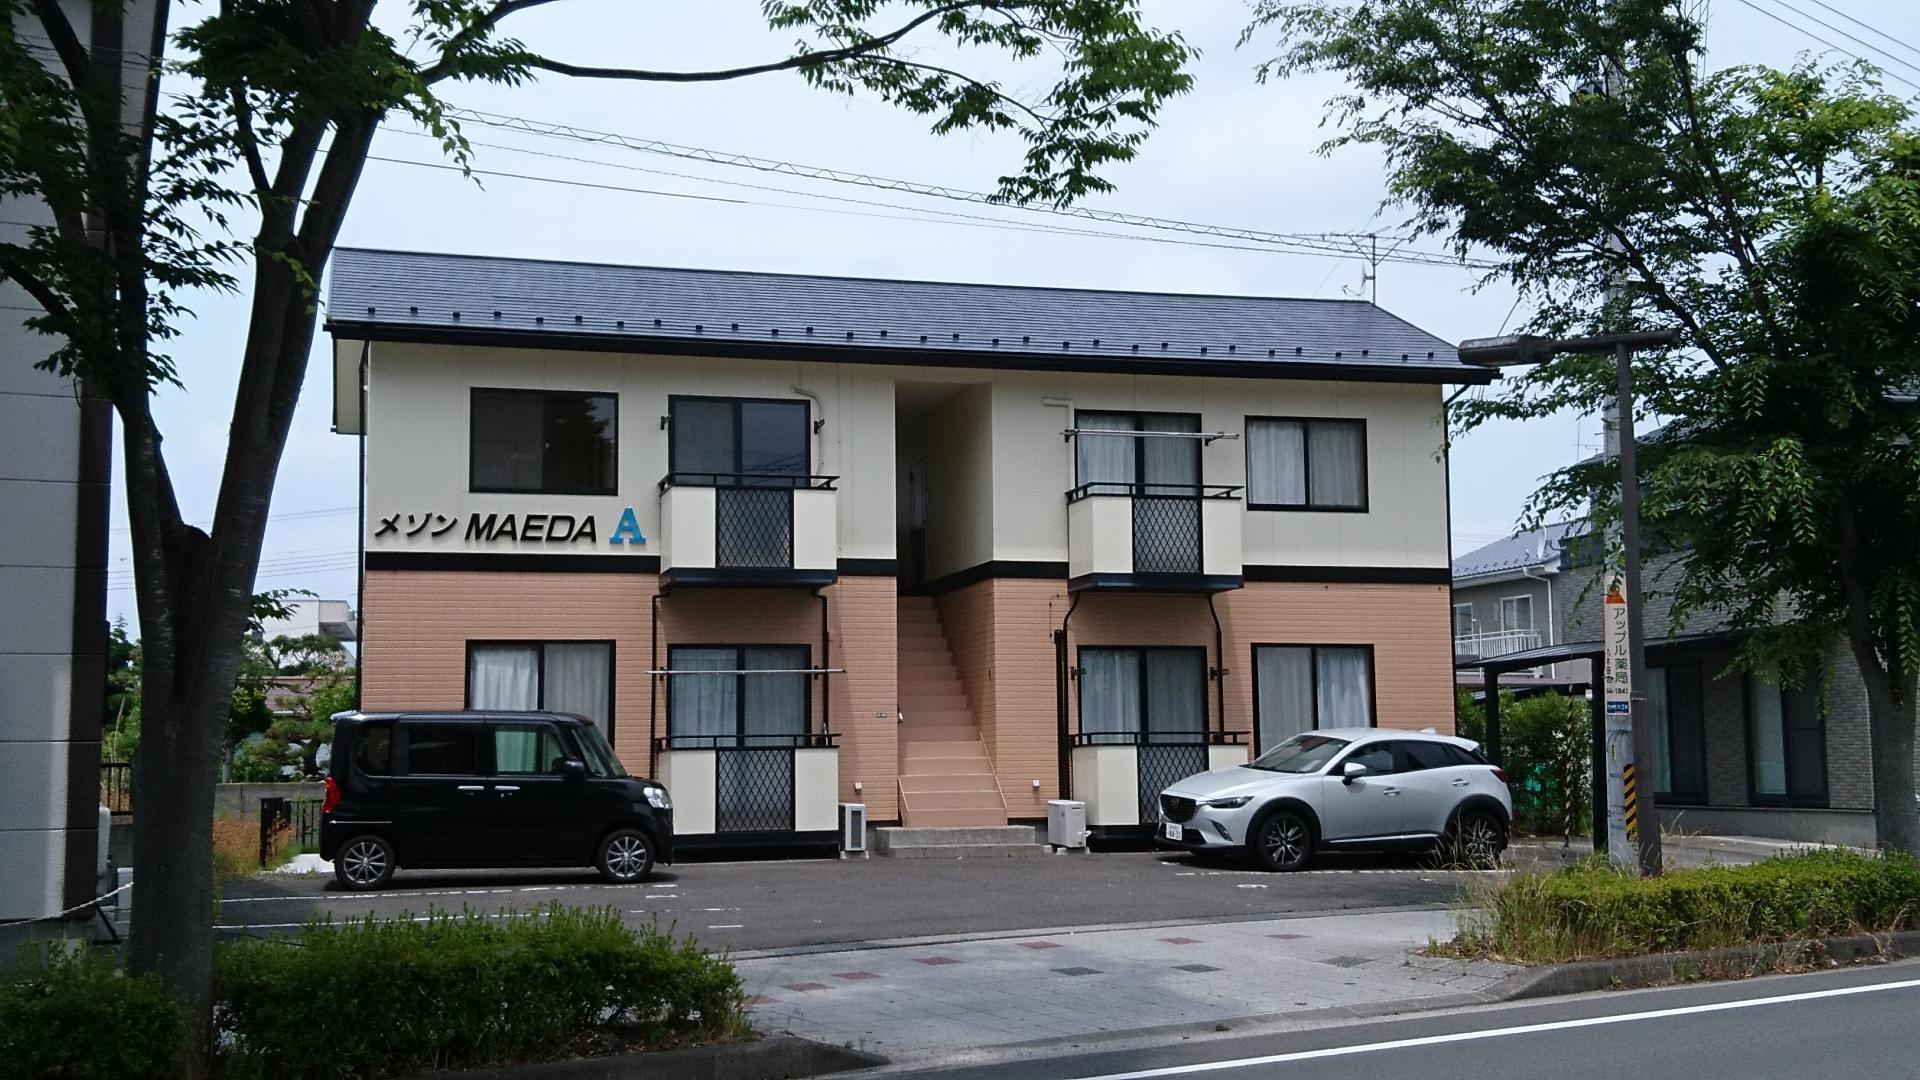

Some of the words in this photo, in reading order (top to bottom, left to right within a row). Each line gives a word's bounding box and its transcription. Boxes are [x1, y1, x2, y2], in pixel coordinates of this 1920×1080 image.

[374, 512, 458, 538] メゾン
[464, 513, 597, 543] MAEDA
[609, 507, 646, 544] A
[1613, 607, 1628, 684] アップル薬局
